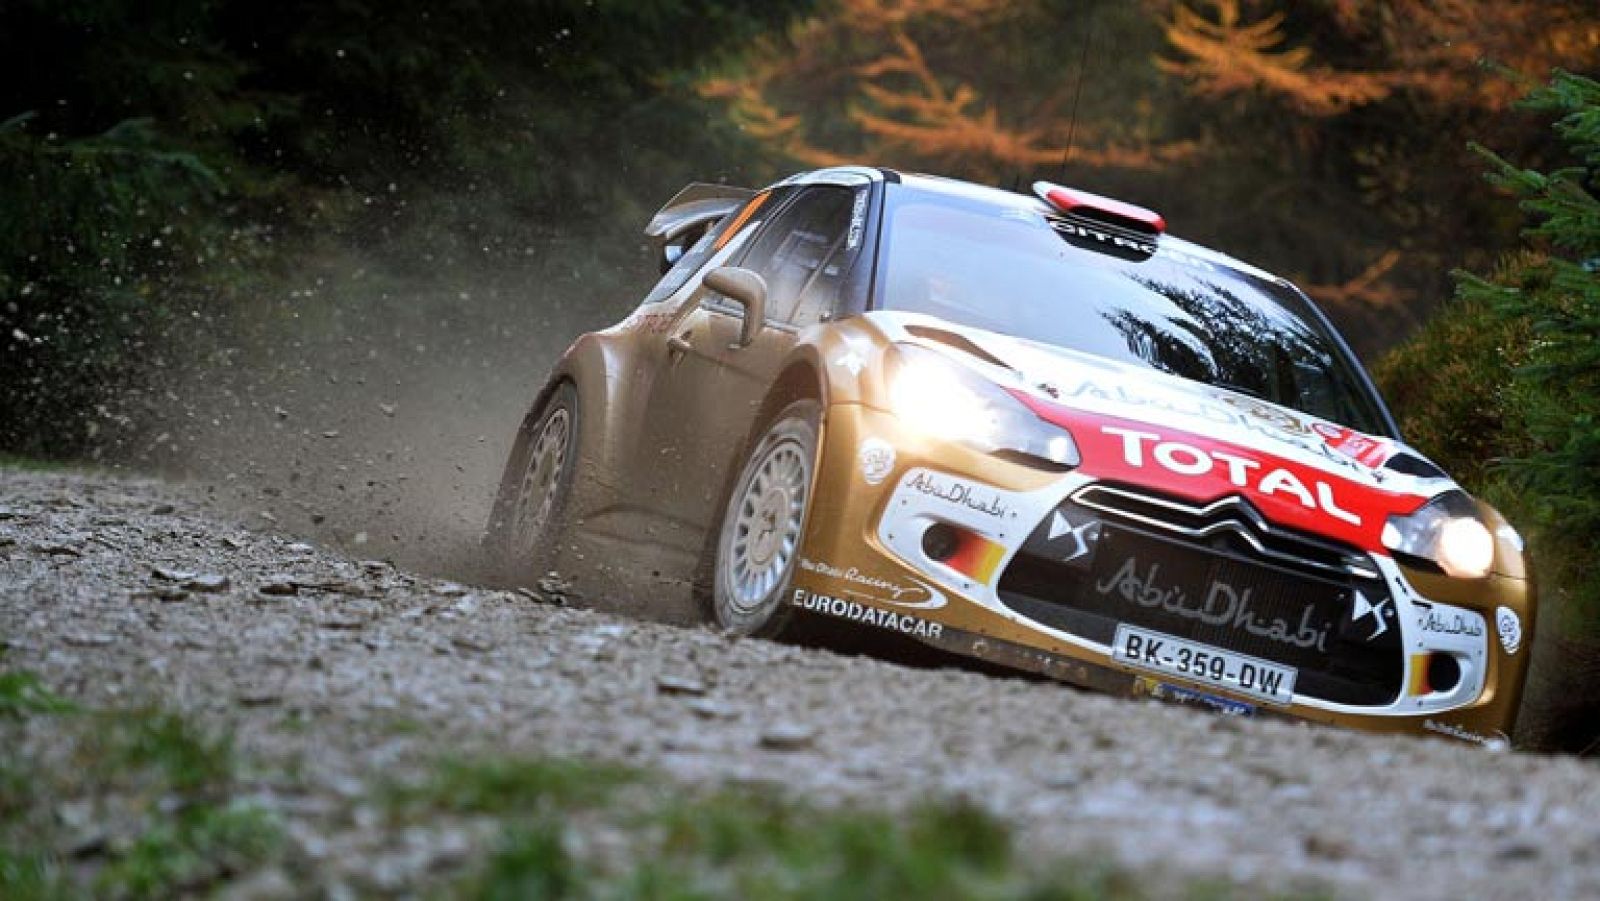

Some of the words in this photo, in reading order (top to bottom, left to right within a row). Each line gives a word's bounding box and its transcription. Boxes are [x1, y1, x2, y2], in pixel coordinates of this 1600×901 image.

[904, 472, 948, 499] Abu
[947, 483, 1006, 518] Dhabi
[1101, 426, 1361, 526] TOTAL
[793, 589, 943, 639] EURODATACAR
[1097, 556, 1198, 614] Abu
[1200, 580, 1332, 652] Dhabi
[1124, 634, 1284, 696] BK-359-DW
